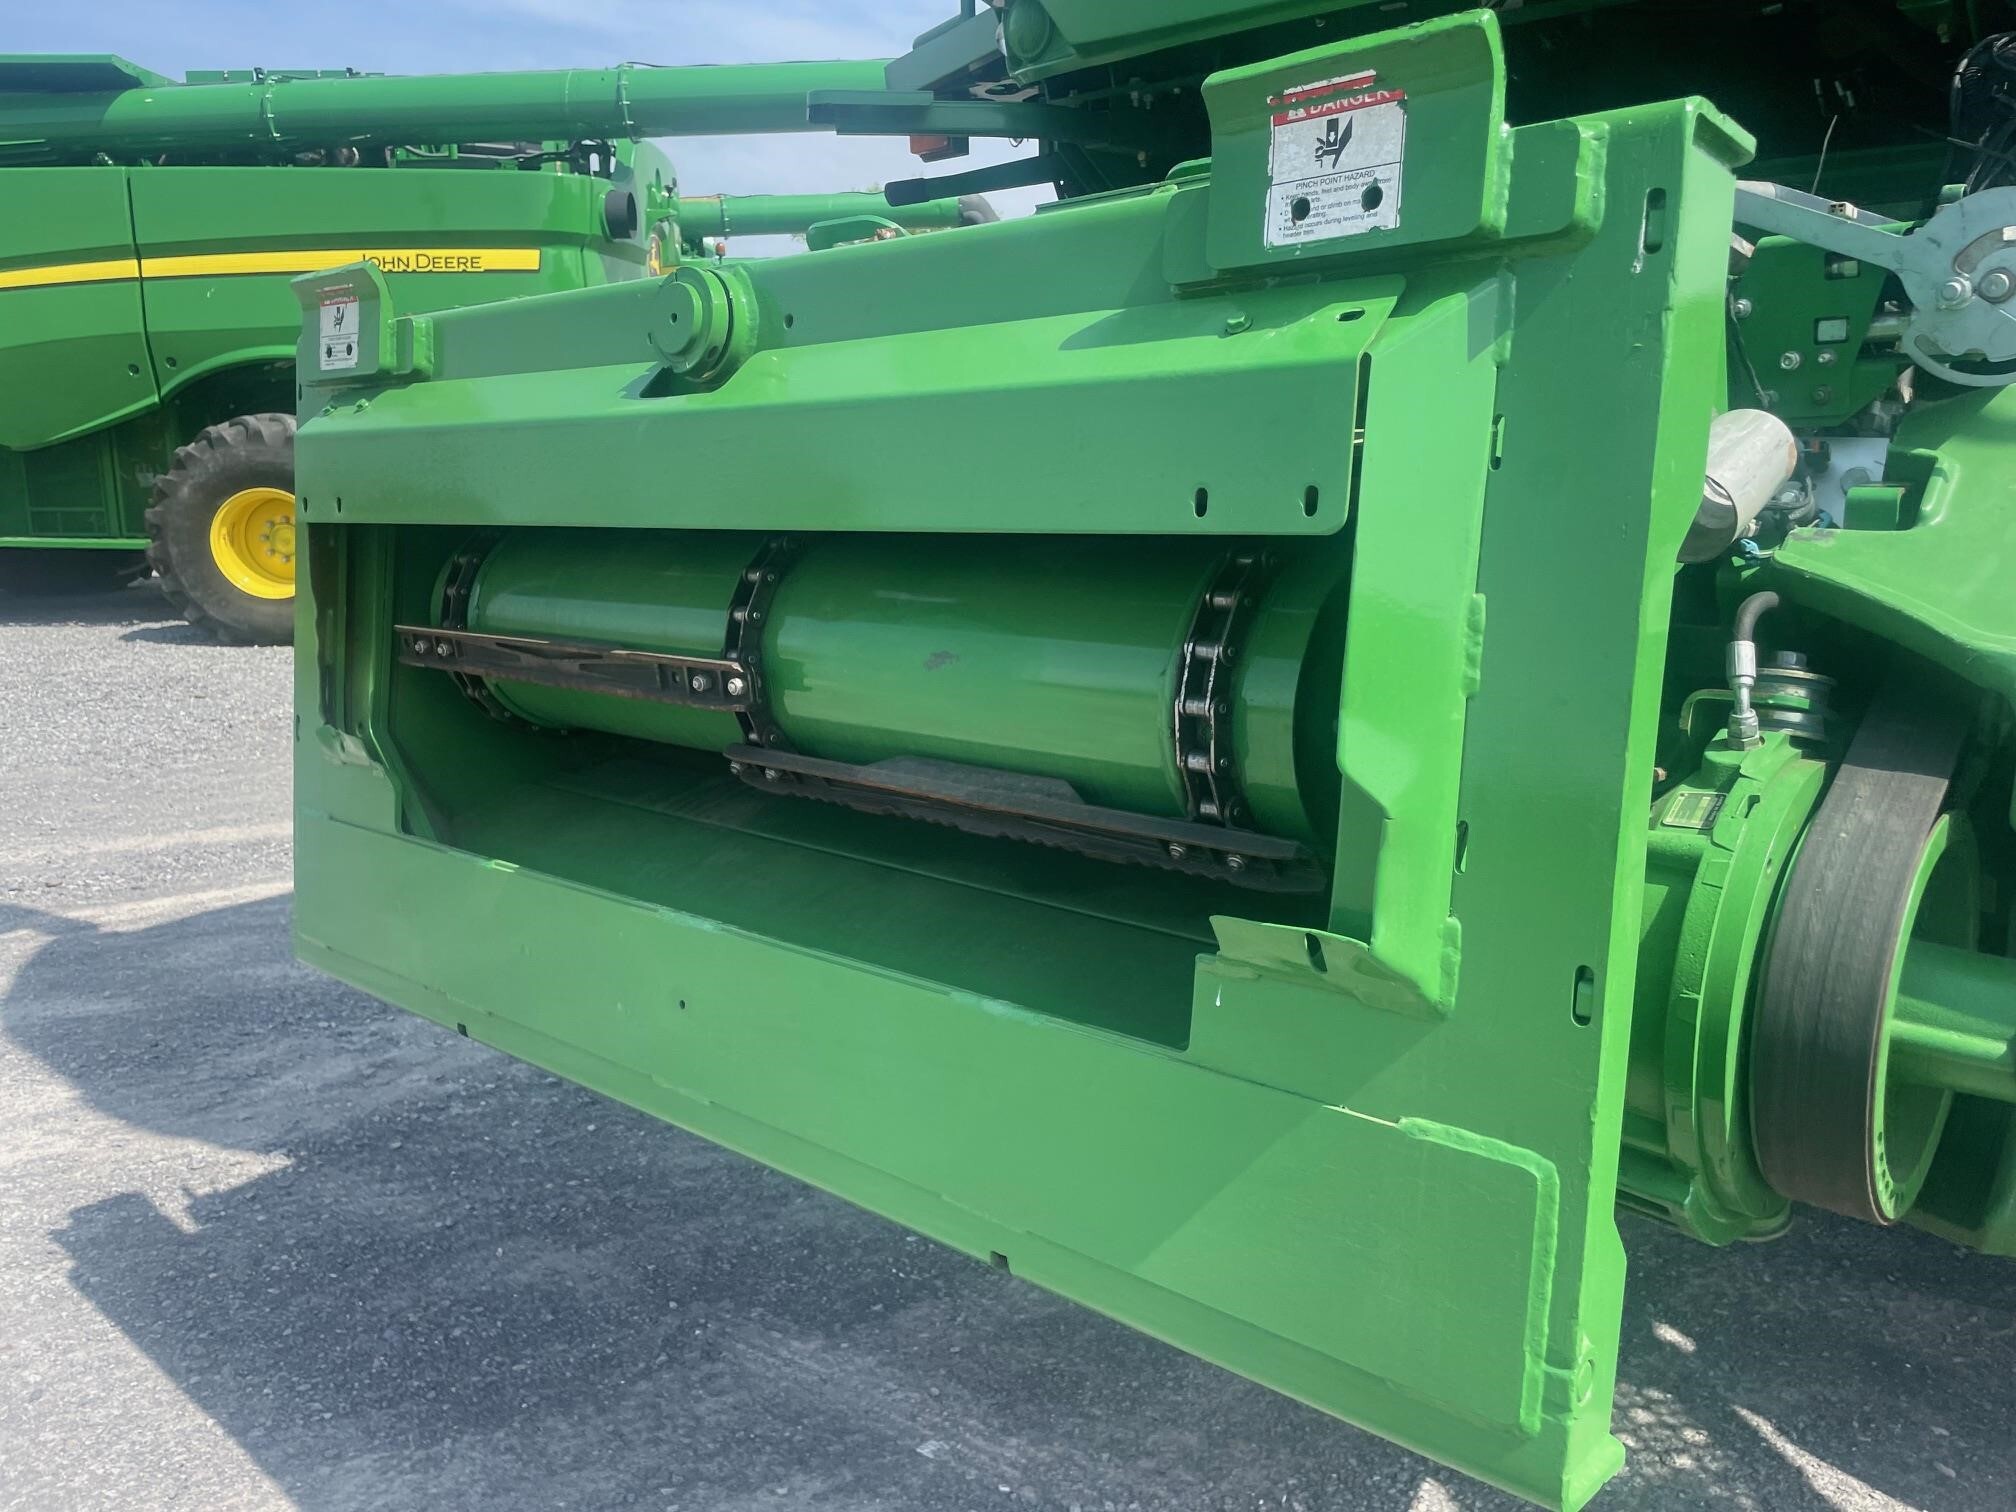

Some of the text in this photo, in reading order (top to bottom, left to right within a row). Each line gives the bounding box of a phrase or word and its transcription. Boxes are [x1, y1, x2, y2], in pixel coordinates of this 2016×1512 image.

[1295, 170, 1376, 190] PINCH POINT HAZARD
[1345, 183, 1359, 192] body
[416, 254, 482, 269] DEERE
